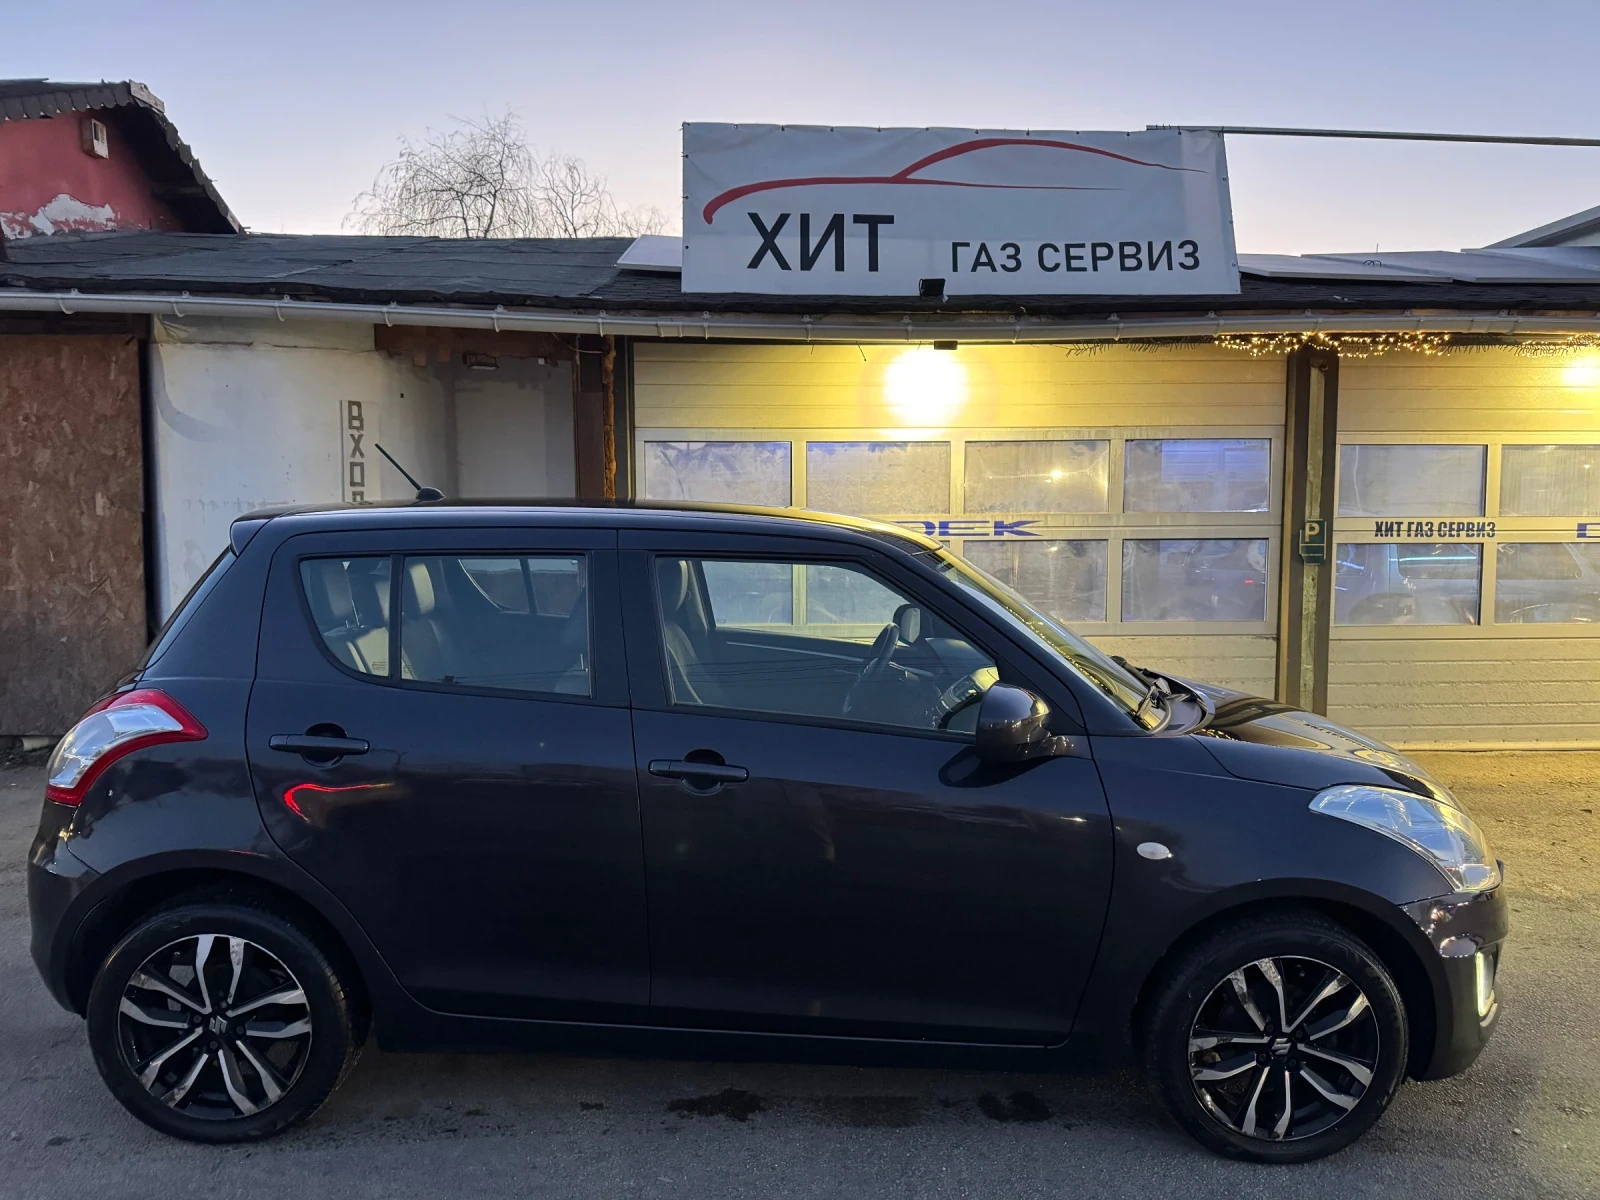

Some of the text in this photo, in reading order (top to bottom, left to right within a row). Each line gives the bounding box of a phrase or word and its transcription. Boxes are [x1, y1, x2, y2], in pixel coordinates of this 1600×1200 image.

[747, 212, 894, 272] ХИТ
[951, 239, 1200, 272] ГАЗ СЕРВИЗ
[1305, 522, 1320, 543] P
[1374, 521, 1496, 538] ХИТ ГАЗ СЕРВИЗ
